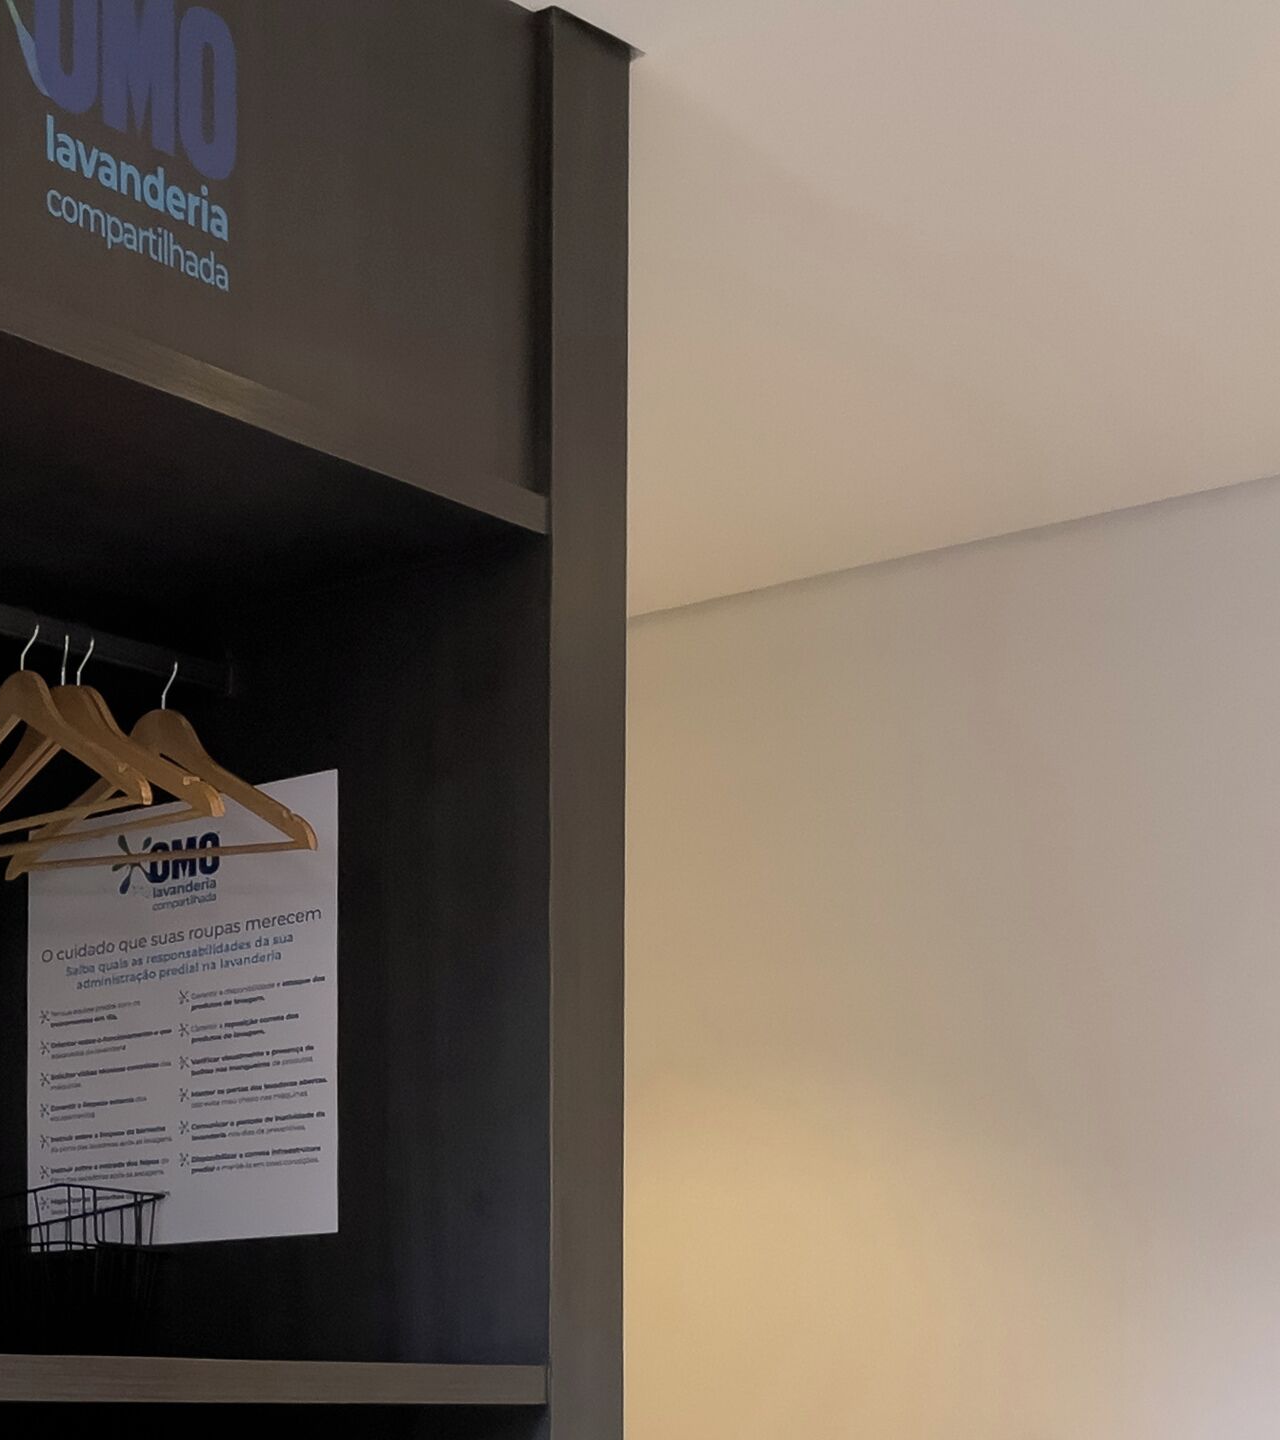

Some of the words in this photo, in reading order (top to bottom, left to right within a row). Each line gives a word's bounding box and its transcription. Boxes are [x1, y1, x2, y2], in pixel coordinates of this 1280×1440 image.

[33, 0, 238, 181] OMO
[46, 114, 229, 242] lavanderia
[47, 188, 230, 293] compartilhada
[149, 831, 220, 884] OMO
[152, 876, 217, 899] lavanderia
[152, 893, 217, 911] compartilhada
[41, 950, 53, 963] O
[56, 941, 115, 961] cuidado
[119, 937, 148, 953] que
[150, 931, 185, 946] suas
[189, 921, 241, 941] roupas
[244, 908, 322, 932] merecem
[65, 965, 95, 978] Saiba
[98, 958, 129, 973] quais
[131, 957, 144, 967] as
[146, 942, 252, 966] responsabilidades
[255, 936, 270, 948] da
[273, 934, 294, 946] sua
[76, 970, 157, 991] administração
[159, 961, 200, 980] predial
[202, 960, 217, 972] na
[220, 951, 282, 969] lavanderia
